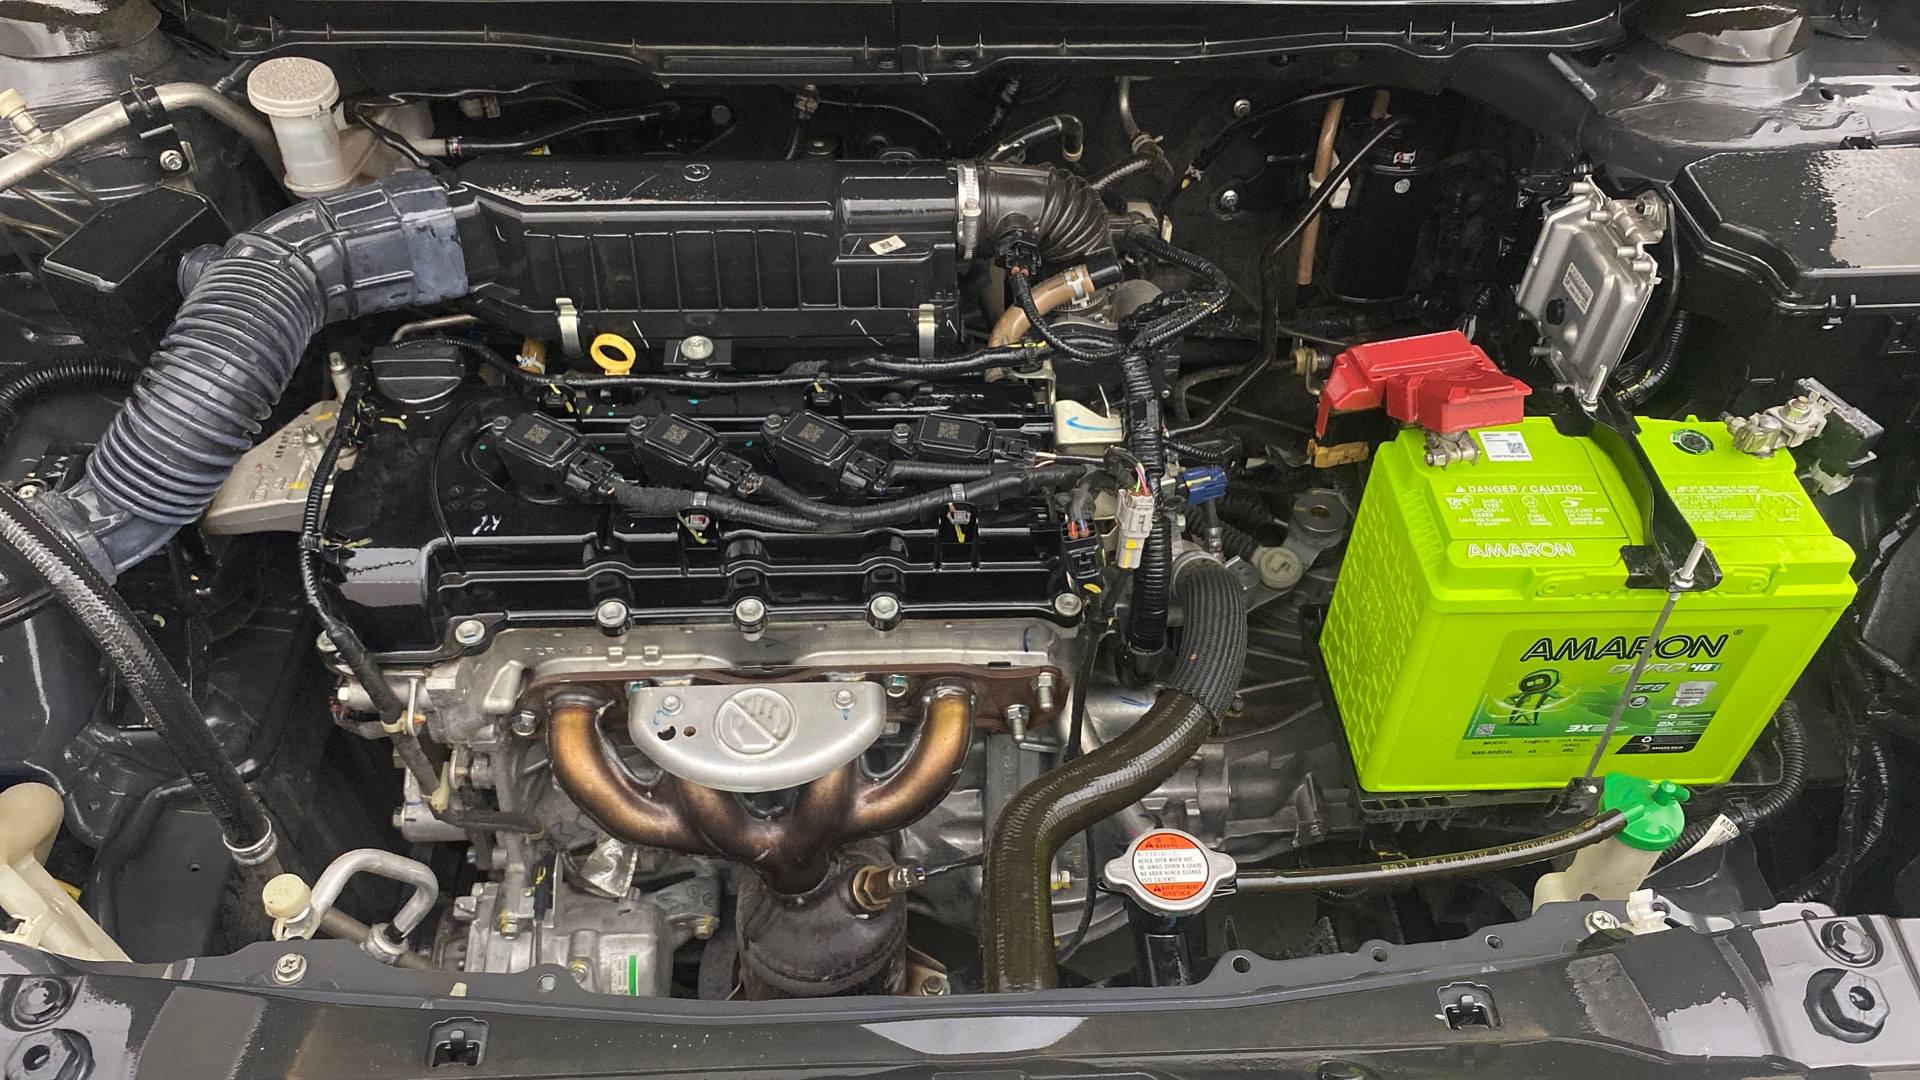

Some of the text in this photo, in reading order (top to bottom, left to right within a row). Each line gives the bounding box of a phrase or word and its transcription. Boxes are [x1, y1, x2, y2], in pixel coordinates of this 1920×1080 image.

[3, 524, 60, 581] NICHIRIN
[1468, 542, 1576, 558] AMARON
[1520, 634, 1729, 662] AMARON
[1565, 724, 1593, 732] 3X
